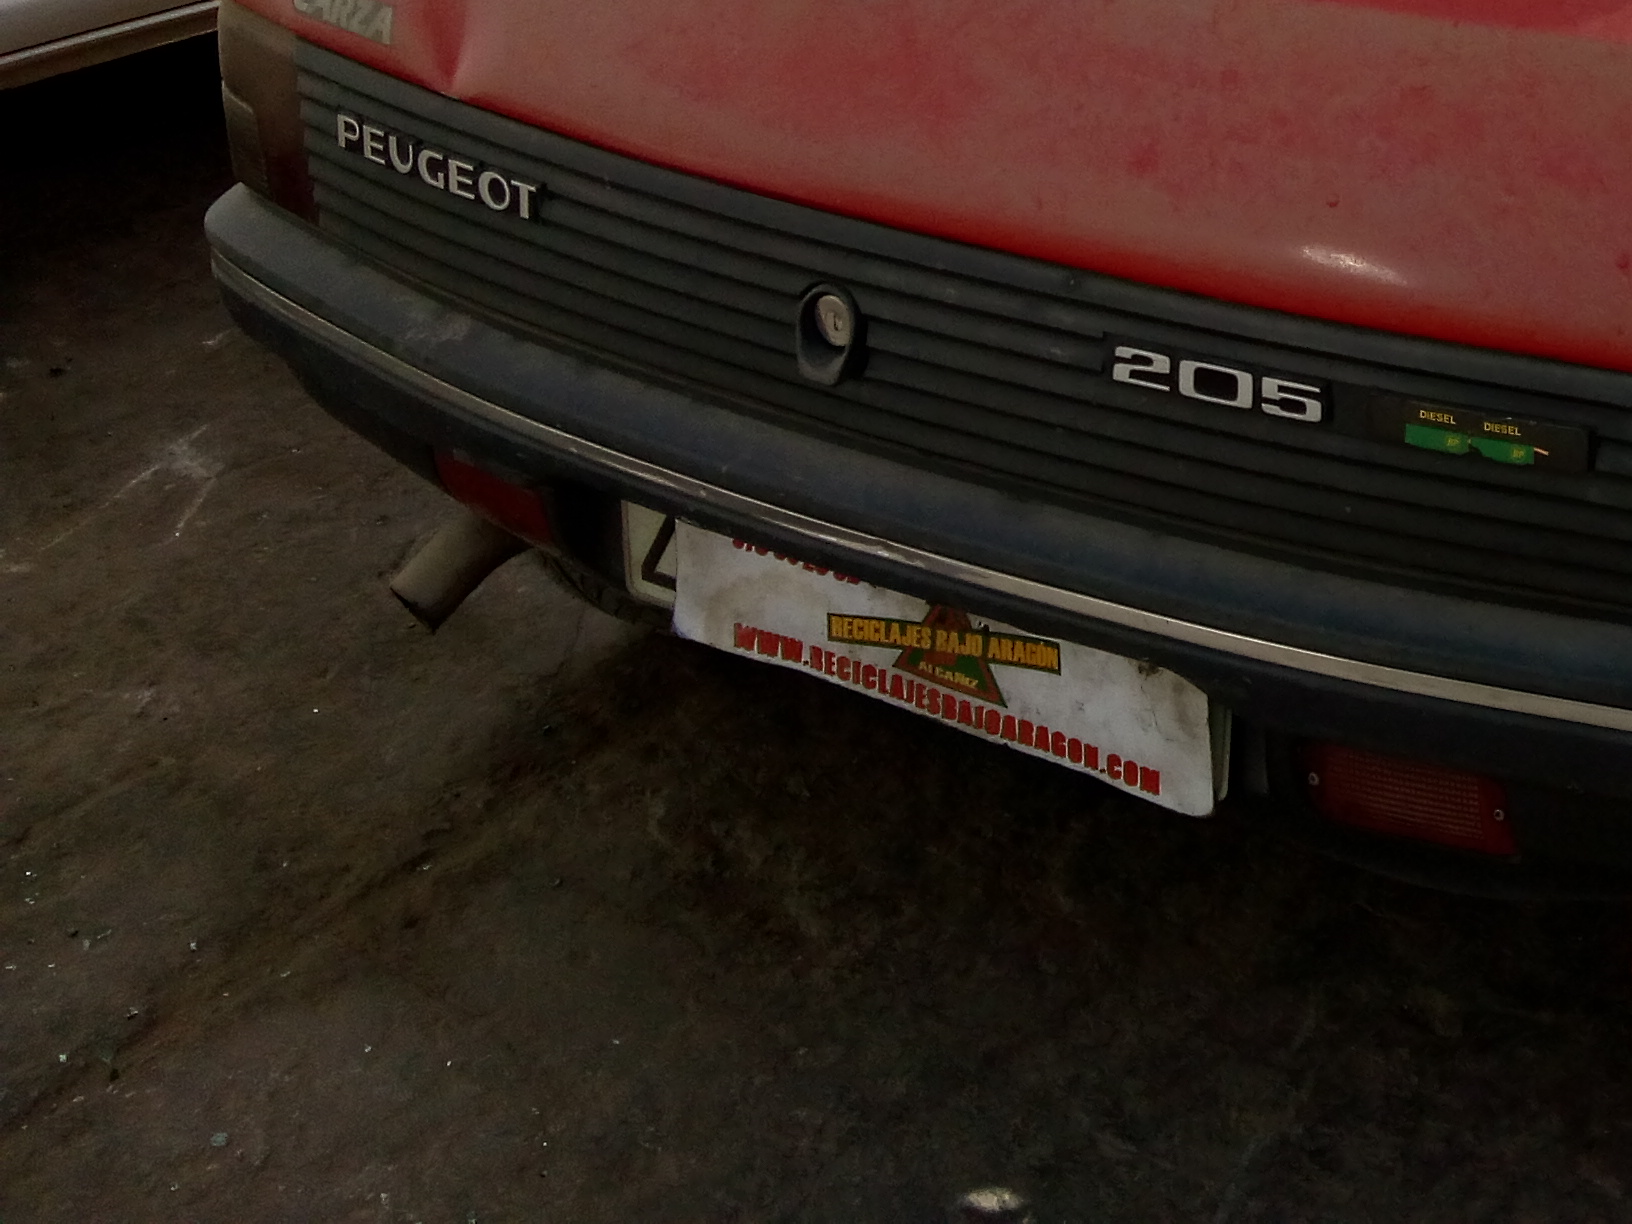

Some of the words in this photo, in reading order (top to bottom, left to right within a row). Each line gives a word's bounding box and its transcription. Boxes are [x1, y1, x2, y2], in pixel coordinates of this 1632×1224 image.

[336, 112, 538, 220] PEUGEOT
[1111, 344, 1324, 425] 205
[1418, 408, 1457, 425] DIESEL
[1483, 421, 1522, 437] DIESEL
[829, 614, 932, 650] RECICLAJES
[935, 629, 983, 658] BAJO
[733, 622, 1161, 796] WWW.RECICLAJESBAJOARAGON.COM
